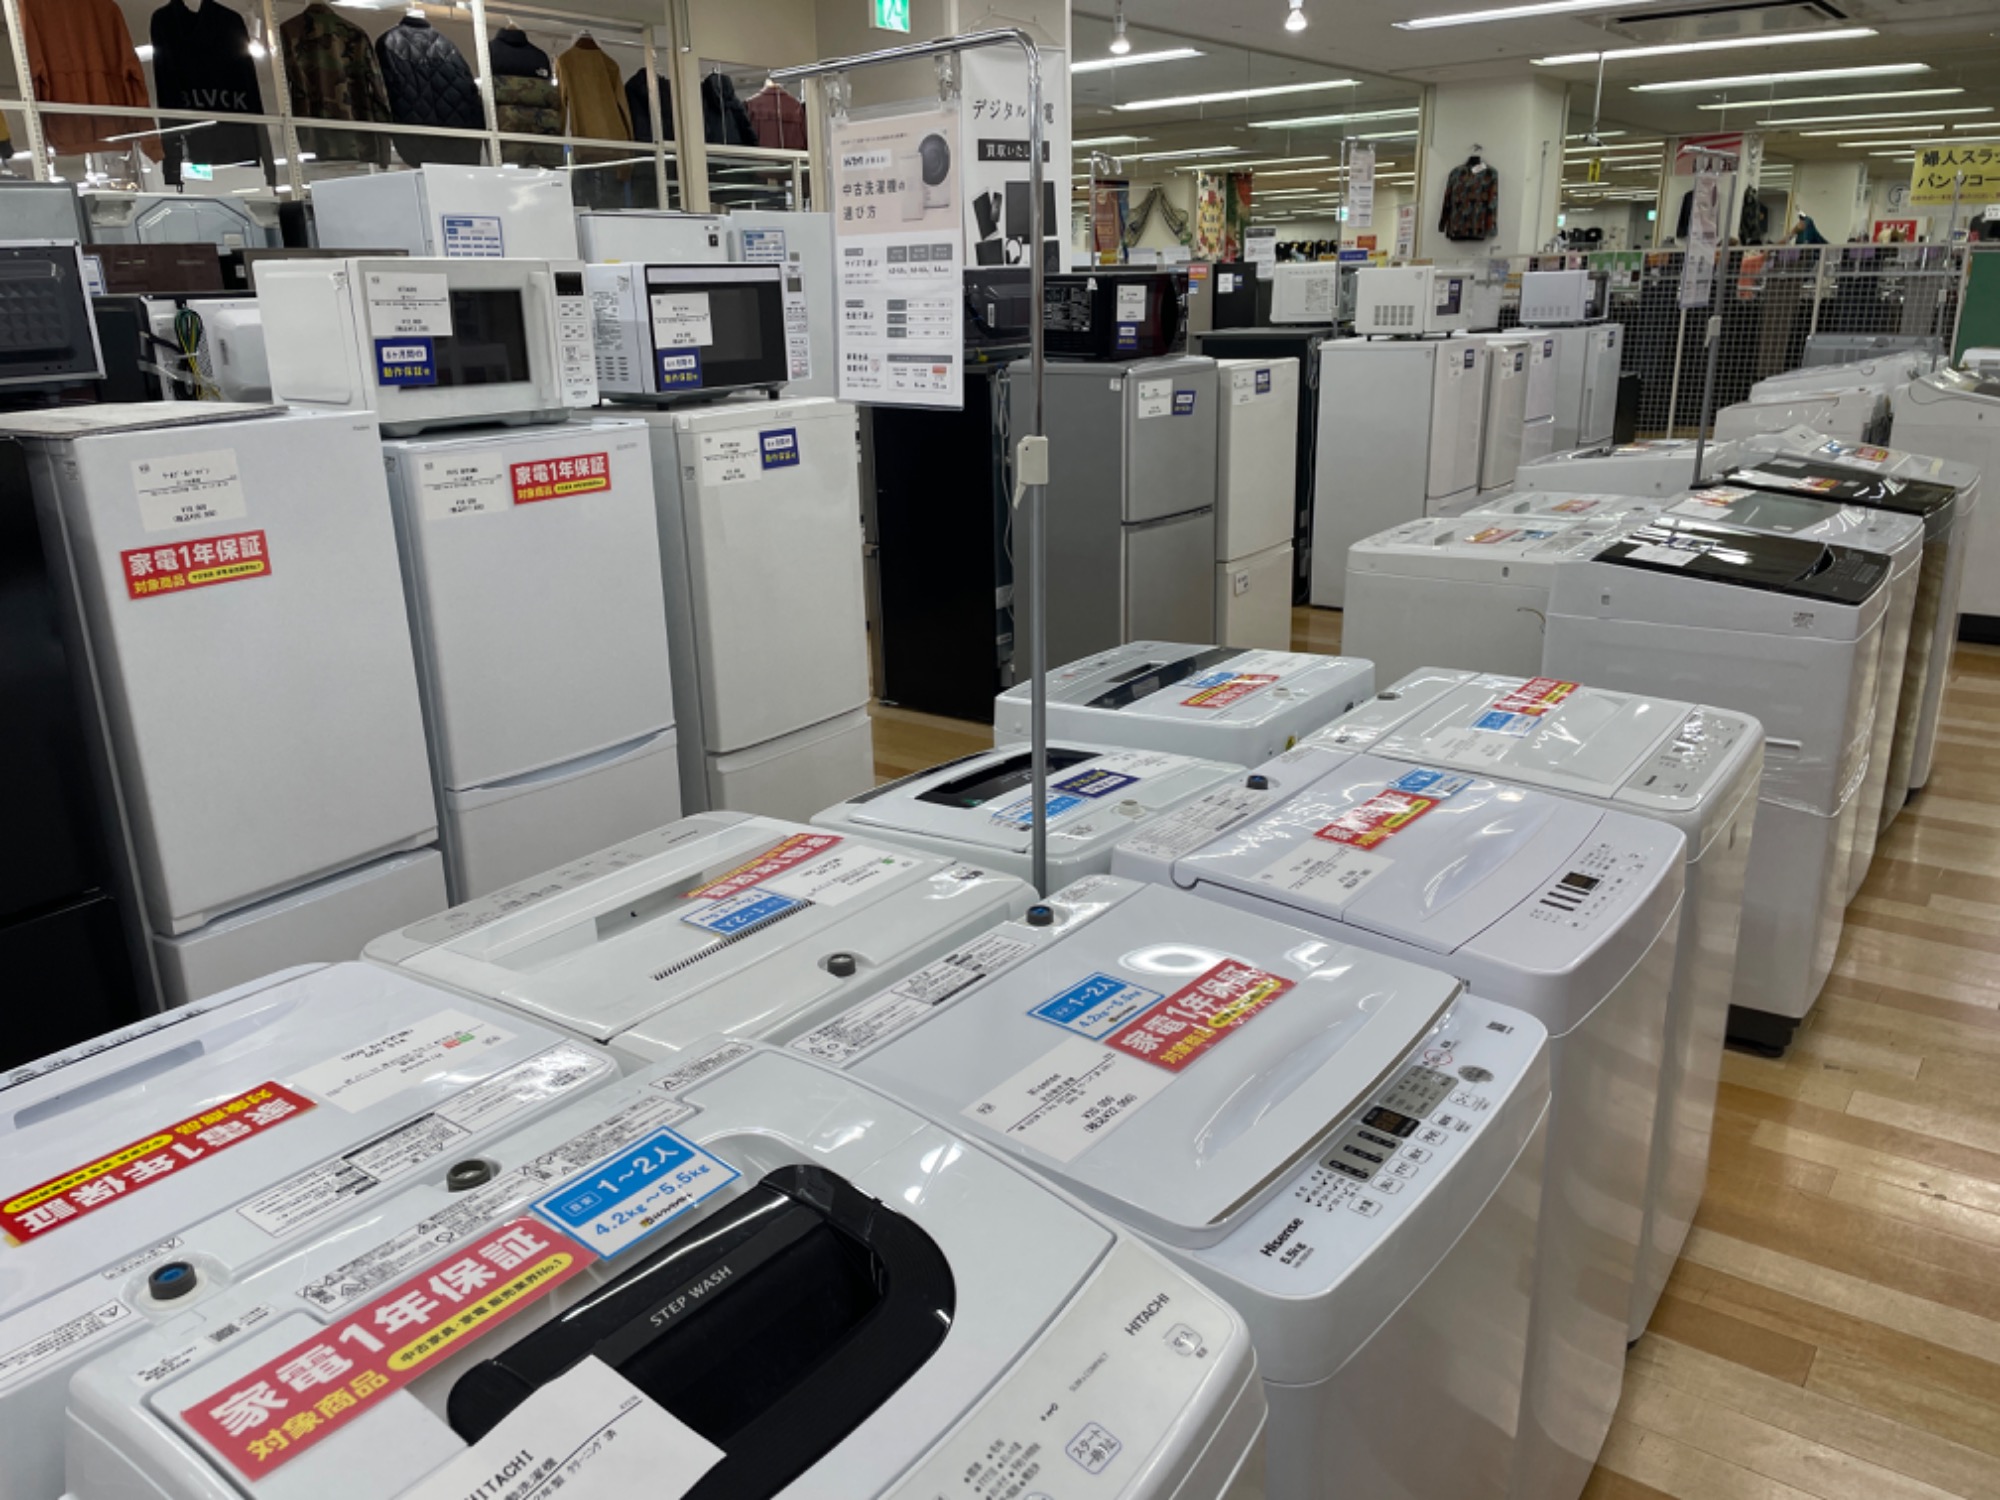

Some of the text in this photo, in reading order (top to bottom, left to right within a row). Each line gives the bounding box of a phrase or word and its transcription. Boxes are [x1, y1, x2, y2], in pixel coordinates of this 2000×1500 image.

[515, 455, 606, 486] 家電1年保証
[128, 535, 263, 577] 家電1年保証
[14, 1097, 297, 1233] 家電1年保証
[1259, 1217, 1304, 1257] Hisense
[650, 1265, 734, 1328] STEP WASH
[1124, 1293, 1171, 1337] HITACHI
[208, 1224, 551, 1438] 家電1年保証
[246, 1370, 390, 1462] 対象商品
[1072, 1429, 1102, 1460] スタート
